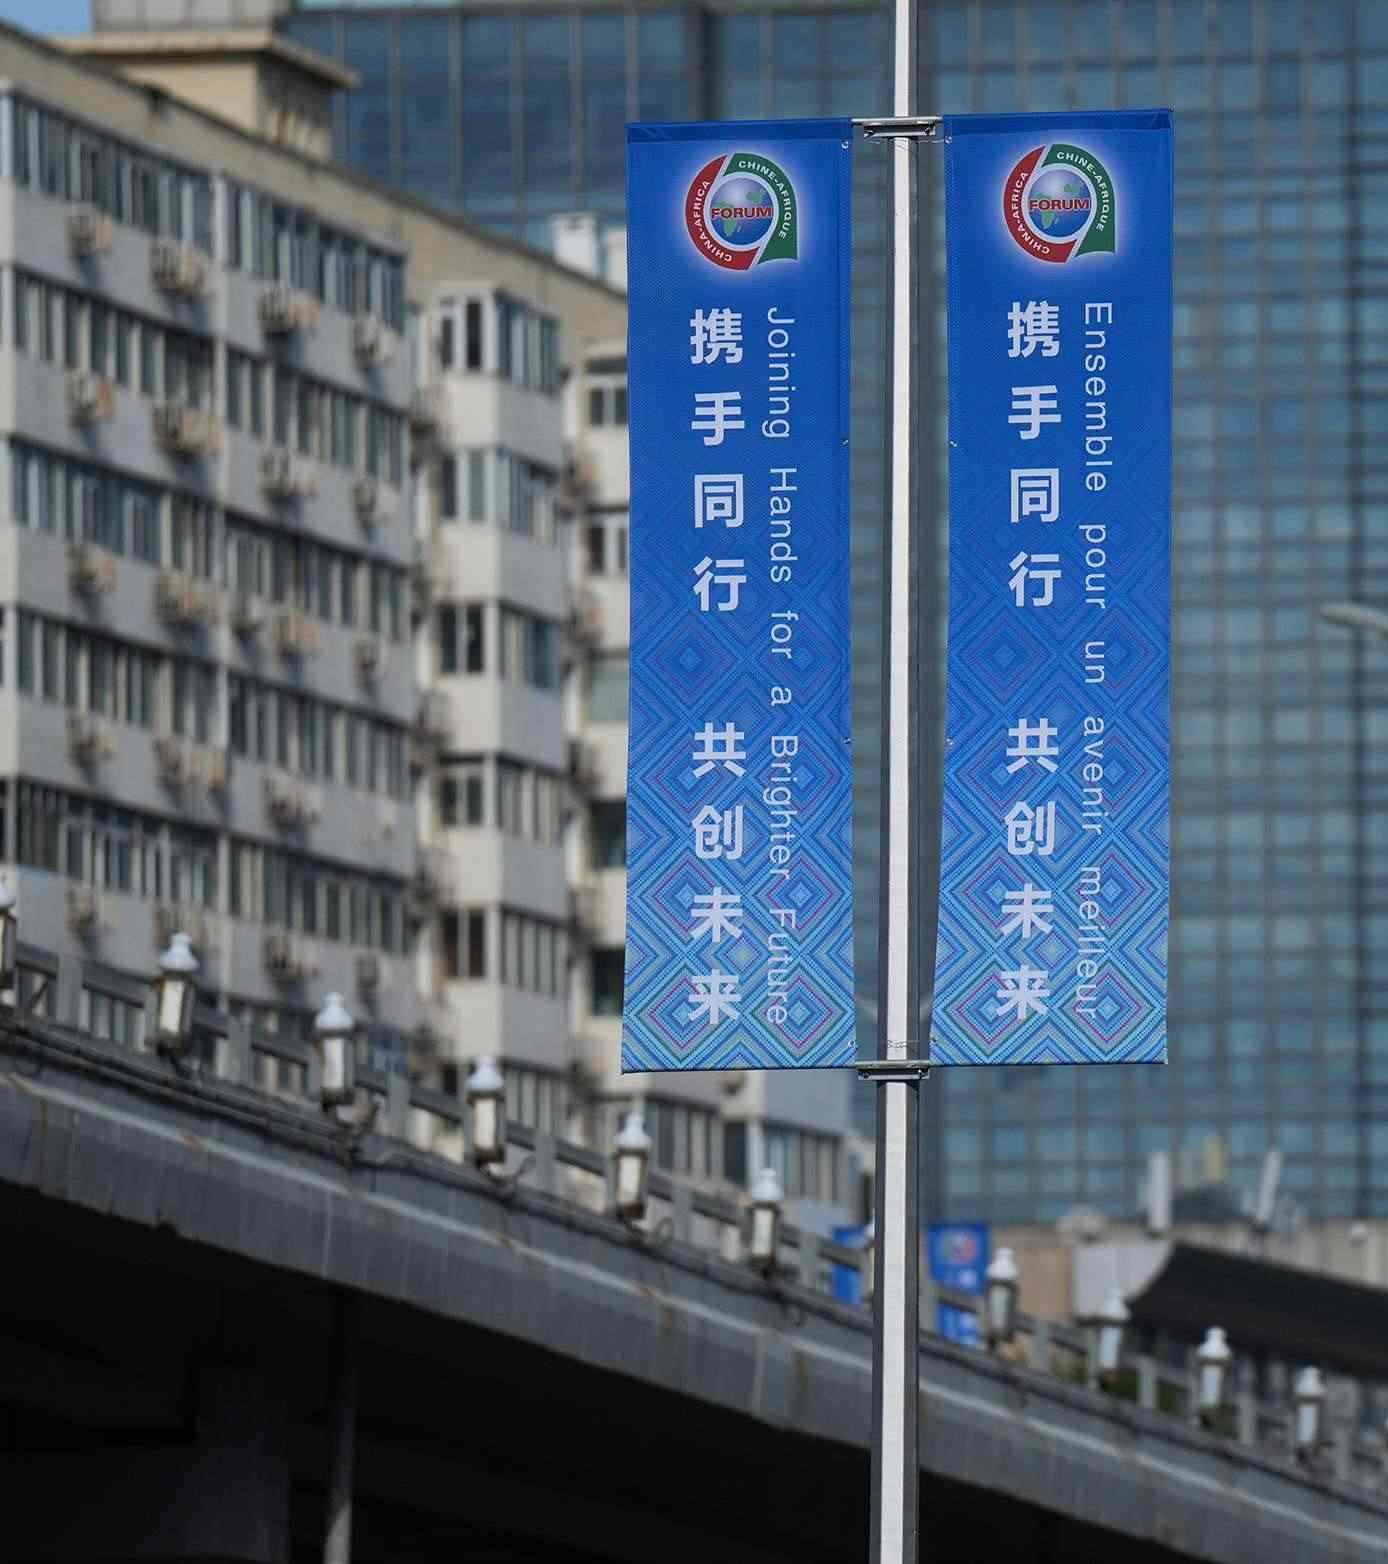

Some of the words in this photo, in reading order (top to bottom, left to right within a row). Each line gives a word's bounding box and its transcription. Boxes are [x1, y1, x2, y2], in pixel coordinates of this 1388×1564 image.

[693, 180, 733, 263] CHINA-AFRICA
[711, 207, 775, 220] FORUM
[738, 160, 792, 240] CHINE-AFRIQUE
[1011, 172, 1051, 255] CHINA-AFRICA
[1029, 199, 1091, 211] FORUM
[1056, 151, 1110, 232] CHINE-AFRIQUE
[761, 307, 796, 440] Joining
[1083, 302, 1113, 492] Ensemble
[690, 308, 747, 613] 携手同行
[1007, 301, 1063, 608] 携手同行
[769, 468, 798, 584] Hands
[1079, 524, 1107, 609] pour
[770, 611, 799, 660] for
[1084, 640, 1106, 684] un
[771, 686, 792, 707] a
[762, 735, 798, 881] Brighter
[1082, 716, 1109, 836] avenir
[687, 722, 747, 1025] 共创未来
[995, 718, 1060, 1021] 共创未来
[766, 908, 796, 1026] Future
[1075, 866, 1107, 1021] meilleur
